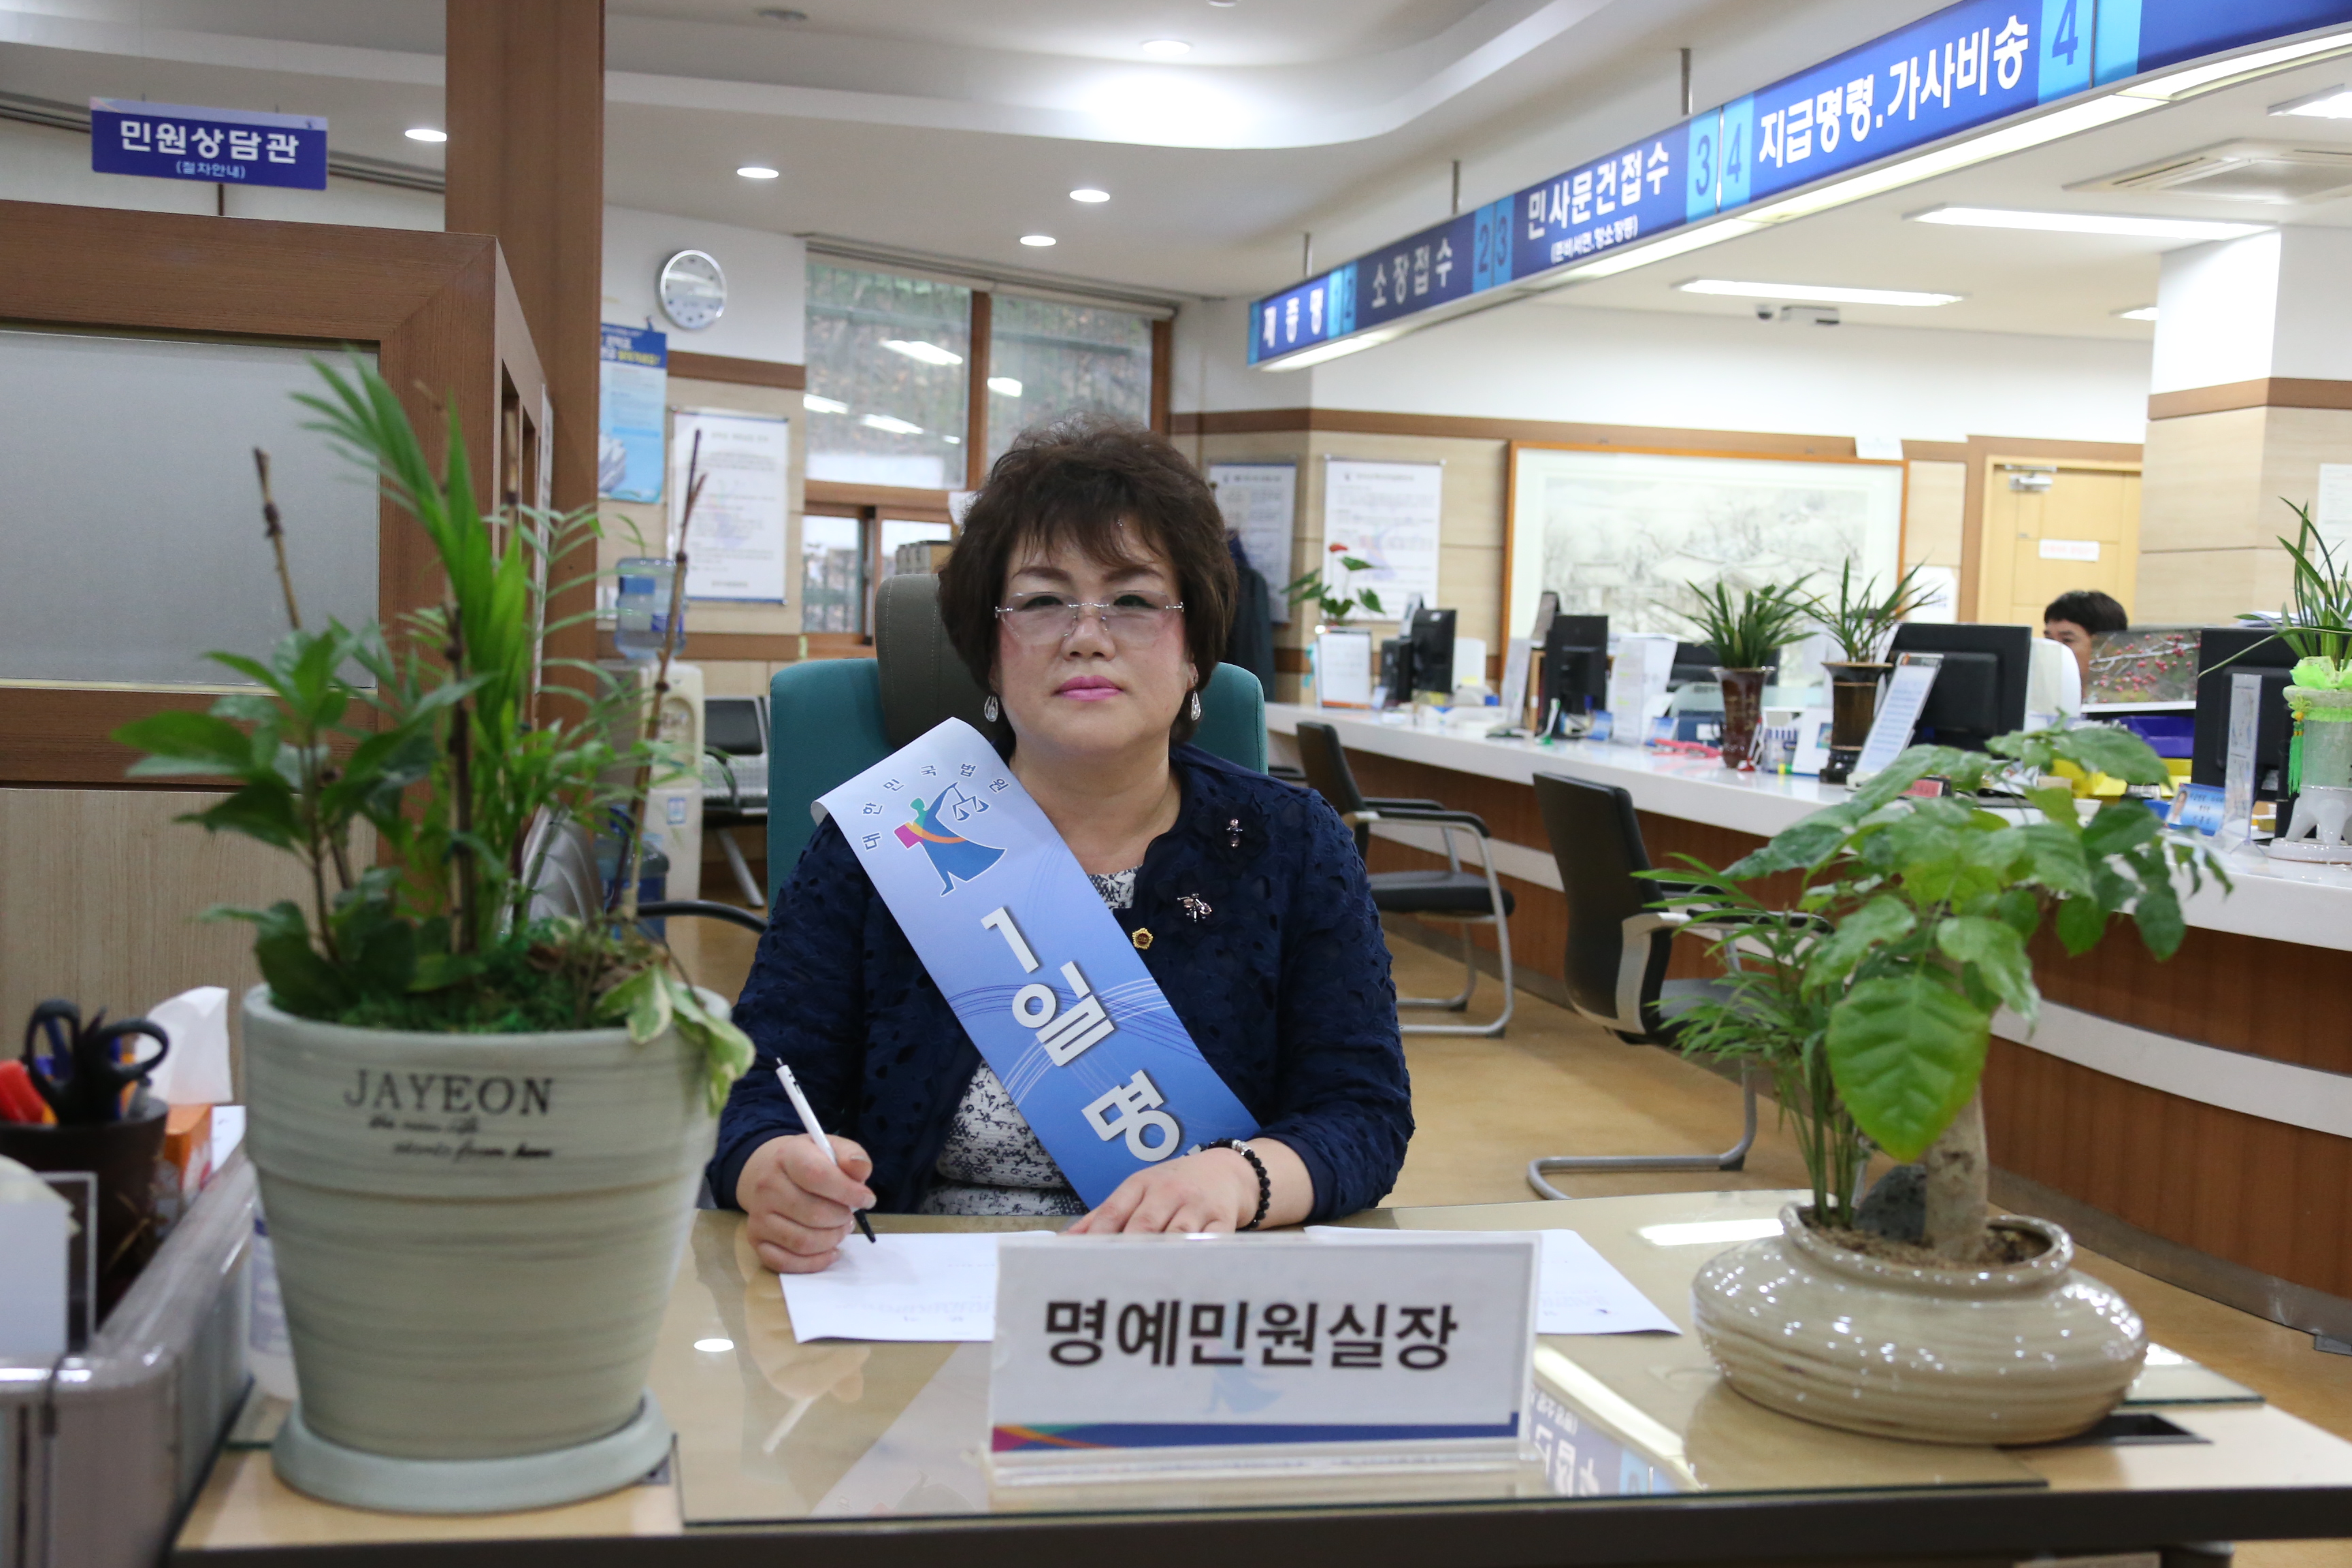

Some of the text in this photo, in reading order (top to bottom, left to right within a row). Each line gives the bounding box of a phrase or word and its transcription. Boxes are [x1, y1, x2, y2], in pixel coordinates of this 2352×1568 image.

[2052, 0, 2079, 66] 4
[120, 119, 299, 165] 민원상담관
[1696, 122, 1742, 197] 3 4
[1527, 141, 1669, 240] 민사문건접수
[1371, 236, 1454, 309] 소장접수
[1478, 216, 1508, 273] 2 3
[343, 1068, 554, 1116] JAYEON
[1081, 1069, 1203, 1163] 명
[1045, 1298, 1458, 1370] 명예민원실장
